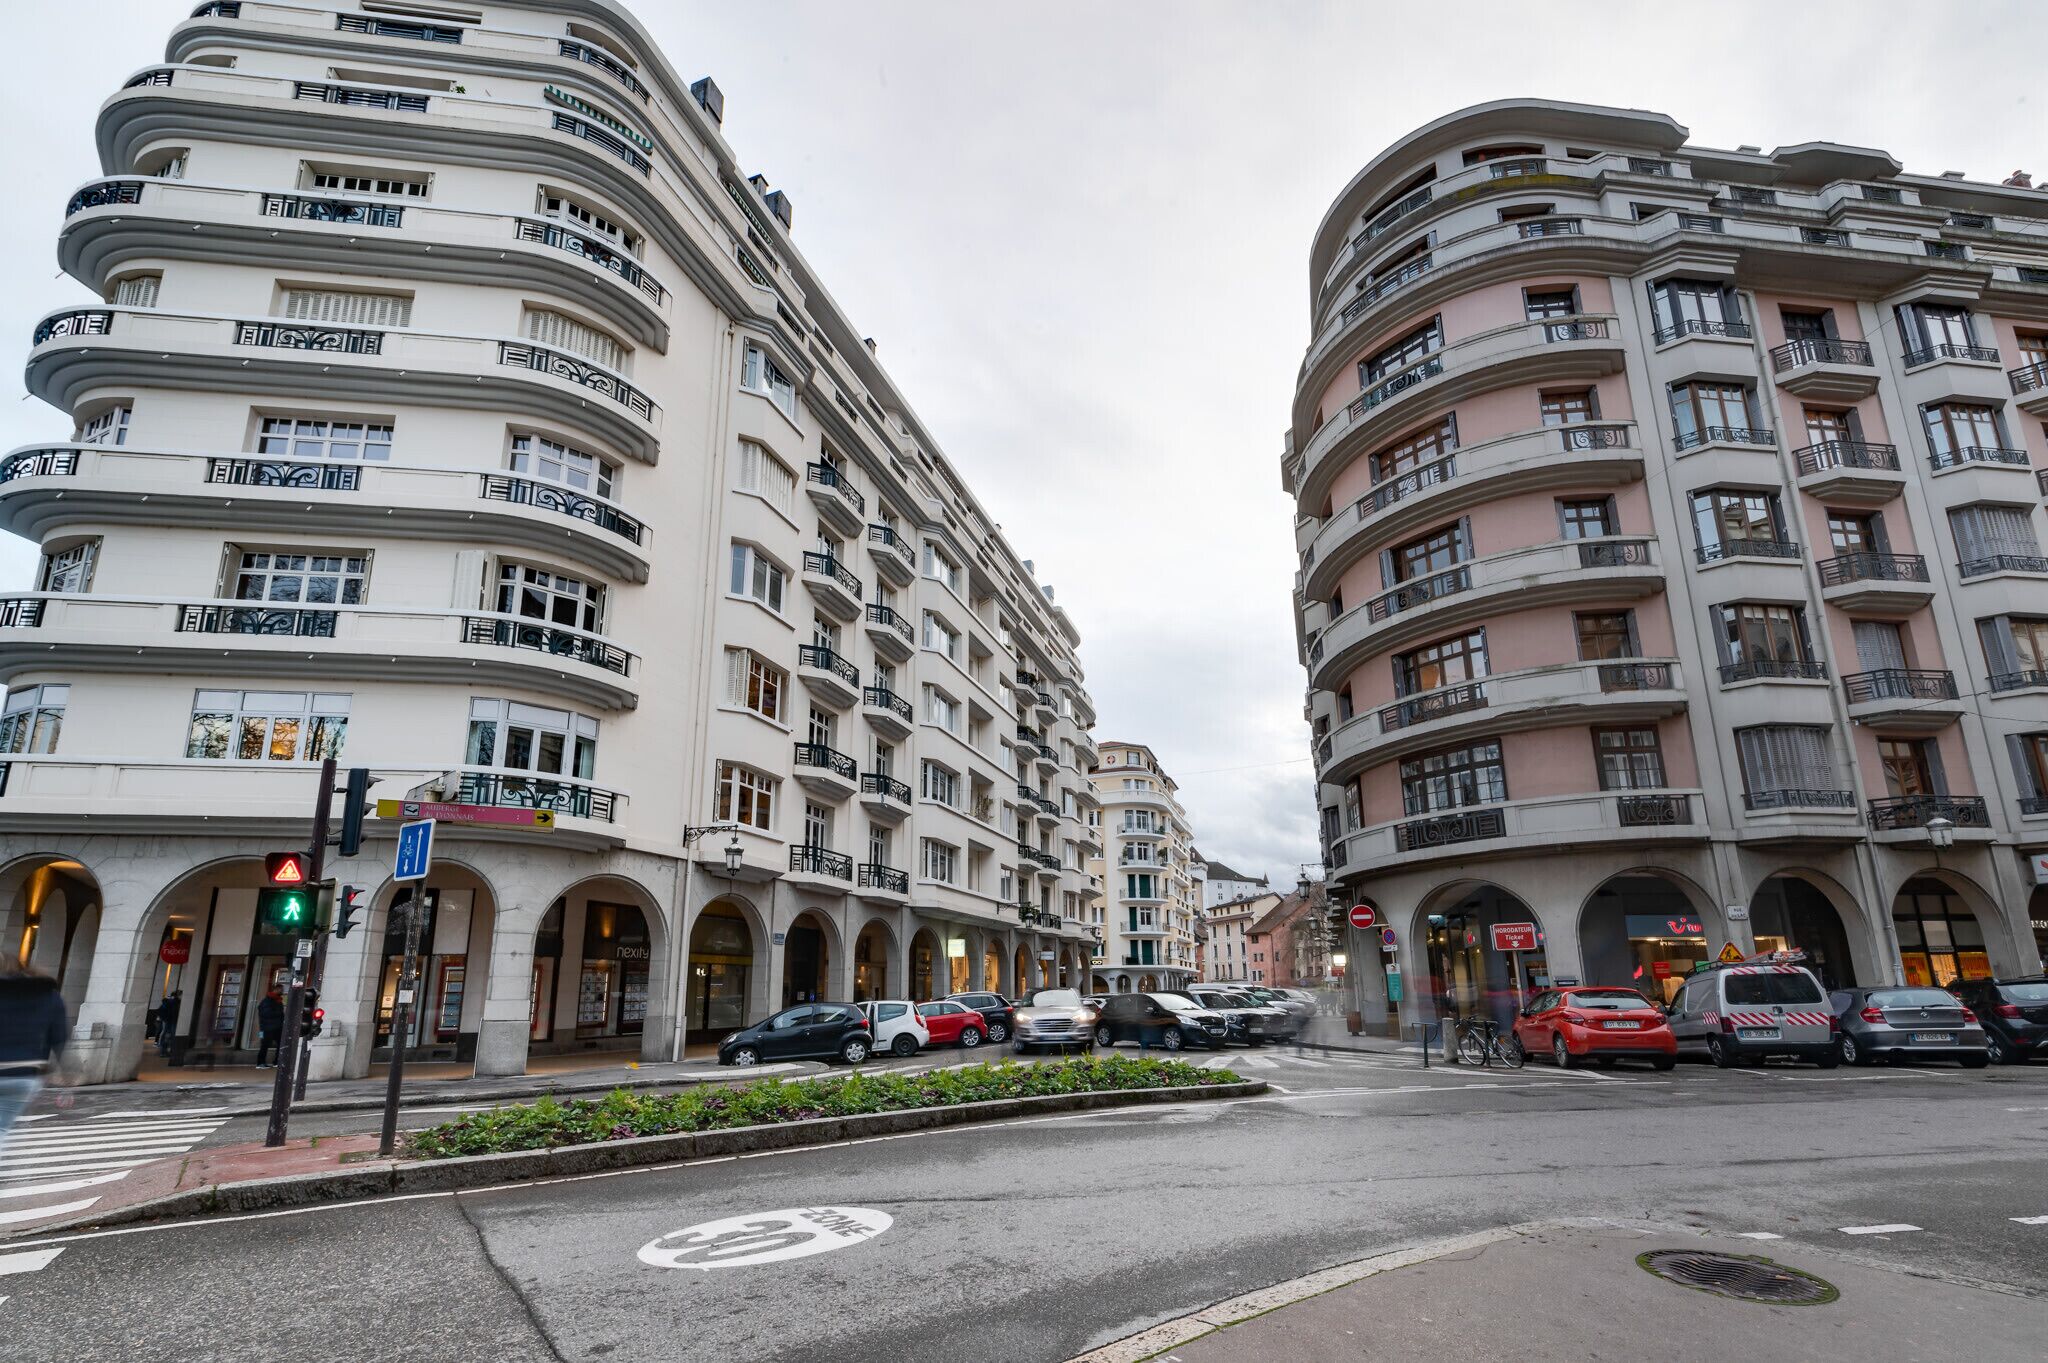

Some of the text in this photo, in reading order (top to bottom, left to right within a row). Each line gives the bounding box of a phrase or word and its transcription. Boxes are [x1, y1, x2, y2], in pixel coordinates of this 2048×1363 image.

[425, 804, 459, 812] AUBERGE
[435, 812, 474, 820] LYONNAIS
[616, 946, 650, 959] nexity
[798, 1208, 877, 1239] ZONE
[654, 1220, 817, 1264] 30
